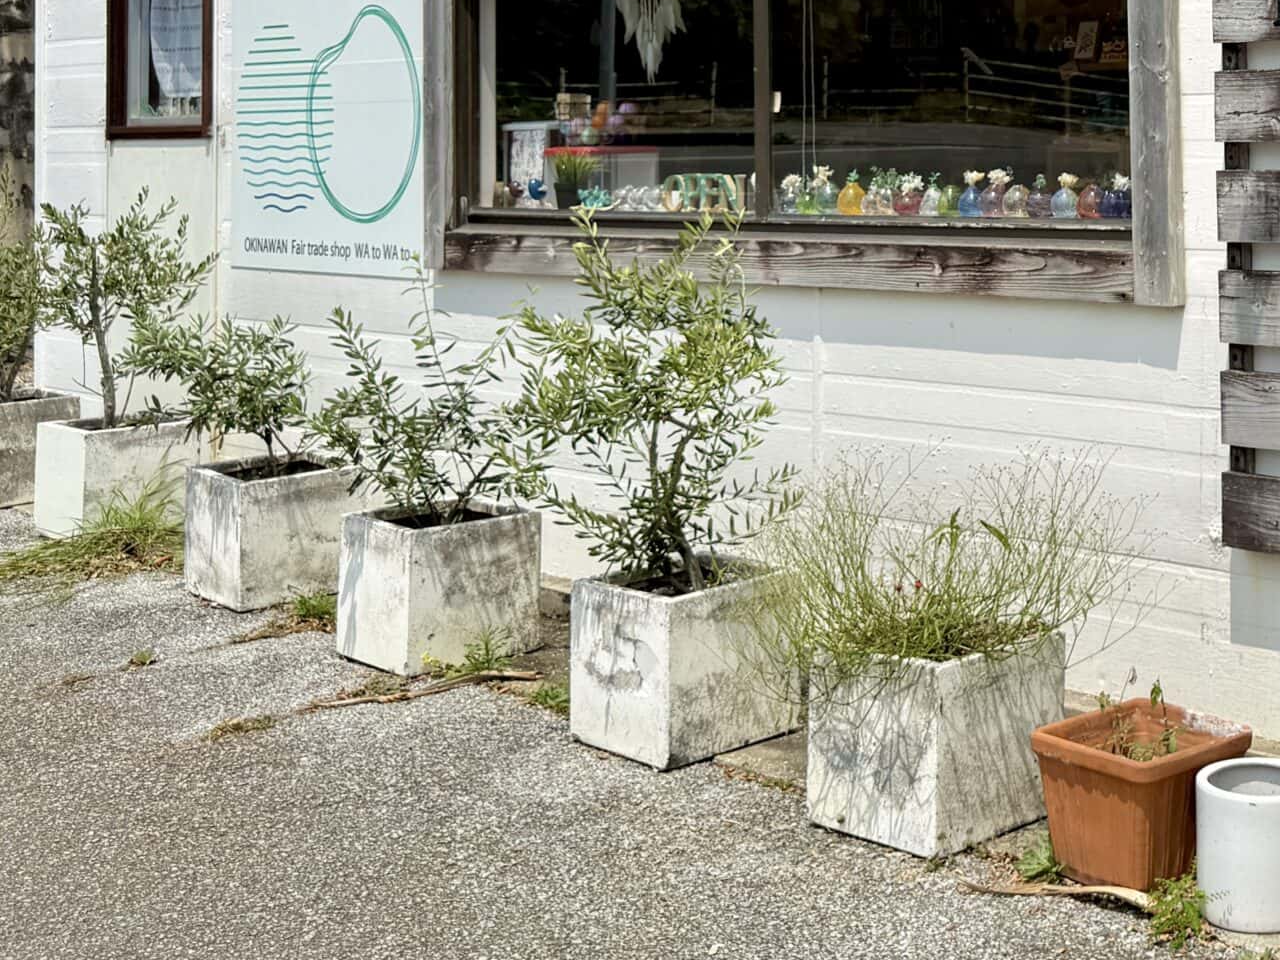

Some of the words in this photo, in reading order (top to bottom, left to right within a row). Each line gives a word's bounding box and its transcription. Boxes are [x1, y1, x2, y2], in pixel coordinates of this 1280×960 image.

[662, 172, 748, 213] OPEN
[244, 237, 288, 255] OKINAWAN
[291, 239, 306, 256] Fair
[307, 240, 329, 257] trade
[330, 241, 351, 262] shop
[354, 242, 370, 260] WA
[372, 245, 381, 260] to
[382, 242, 398, 262] WA
[400, 247, 411, 262] to
